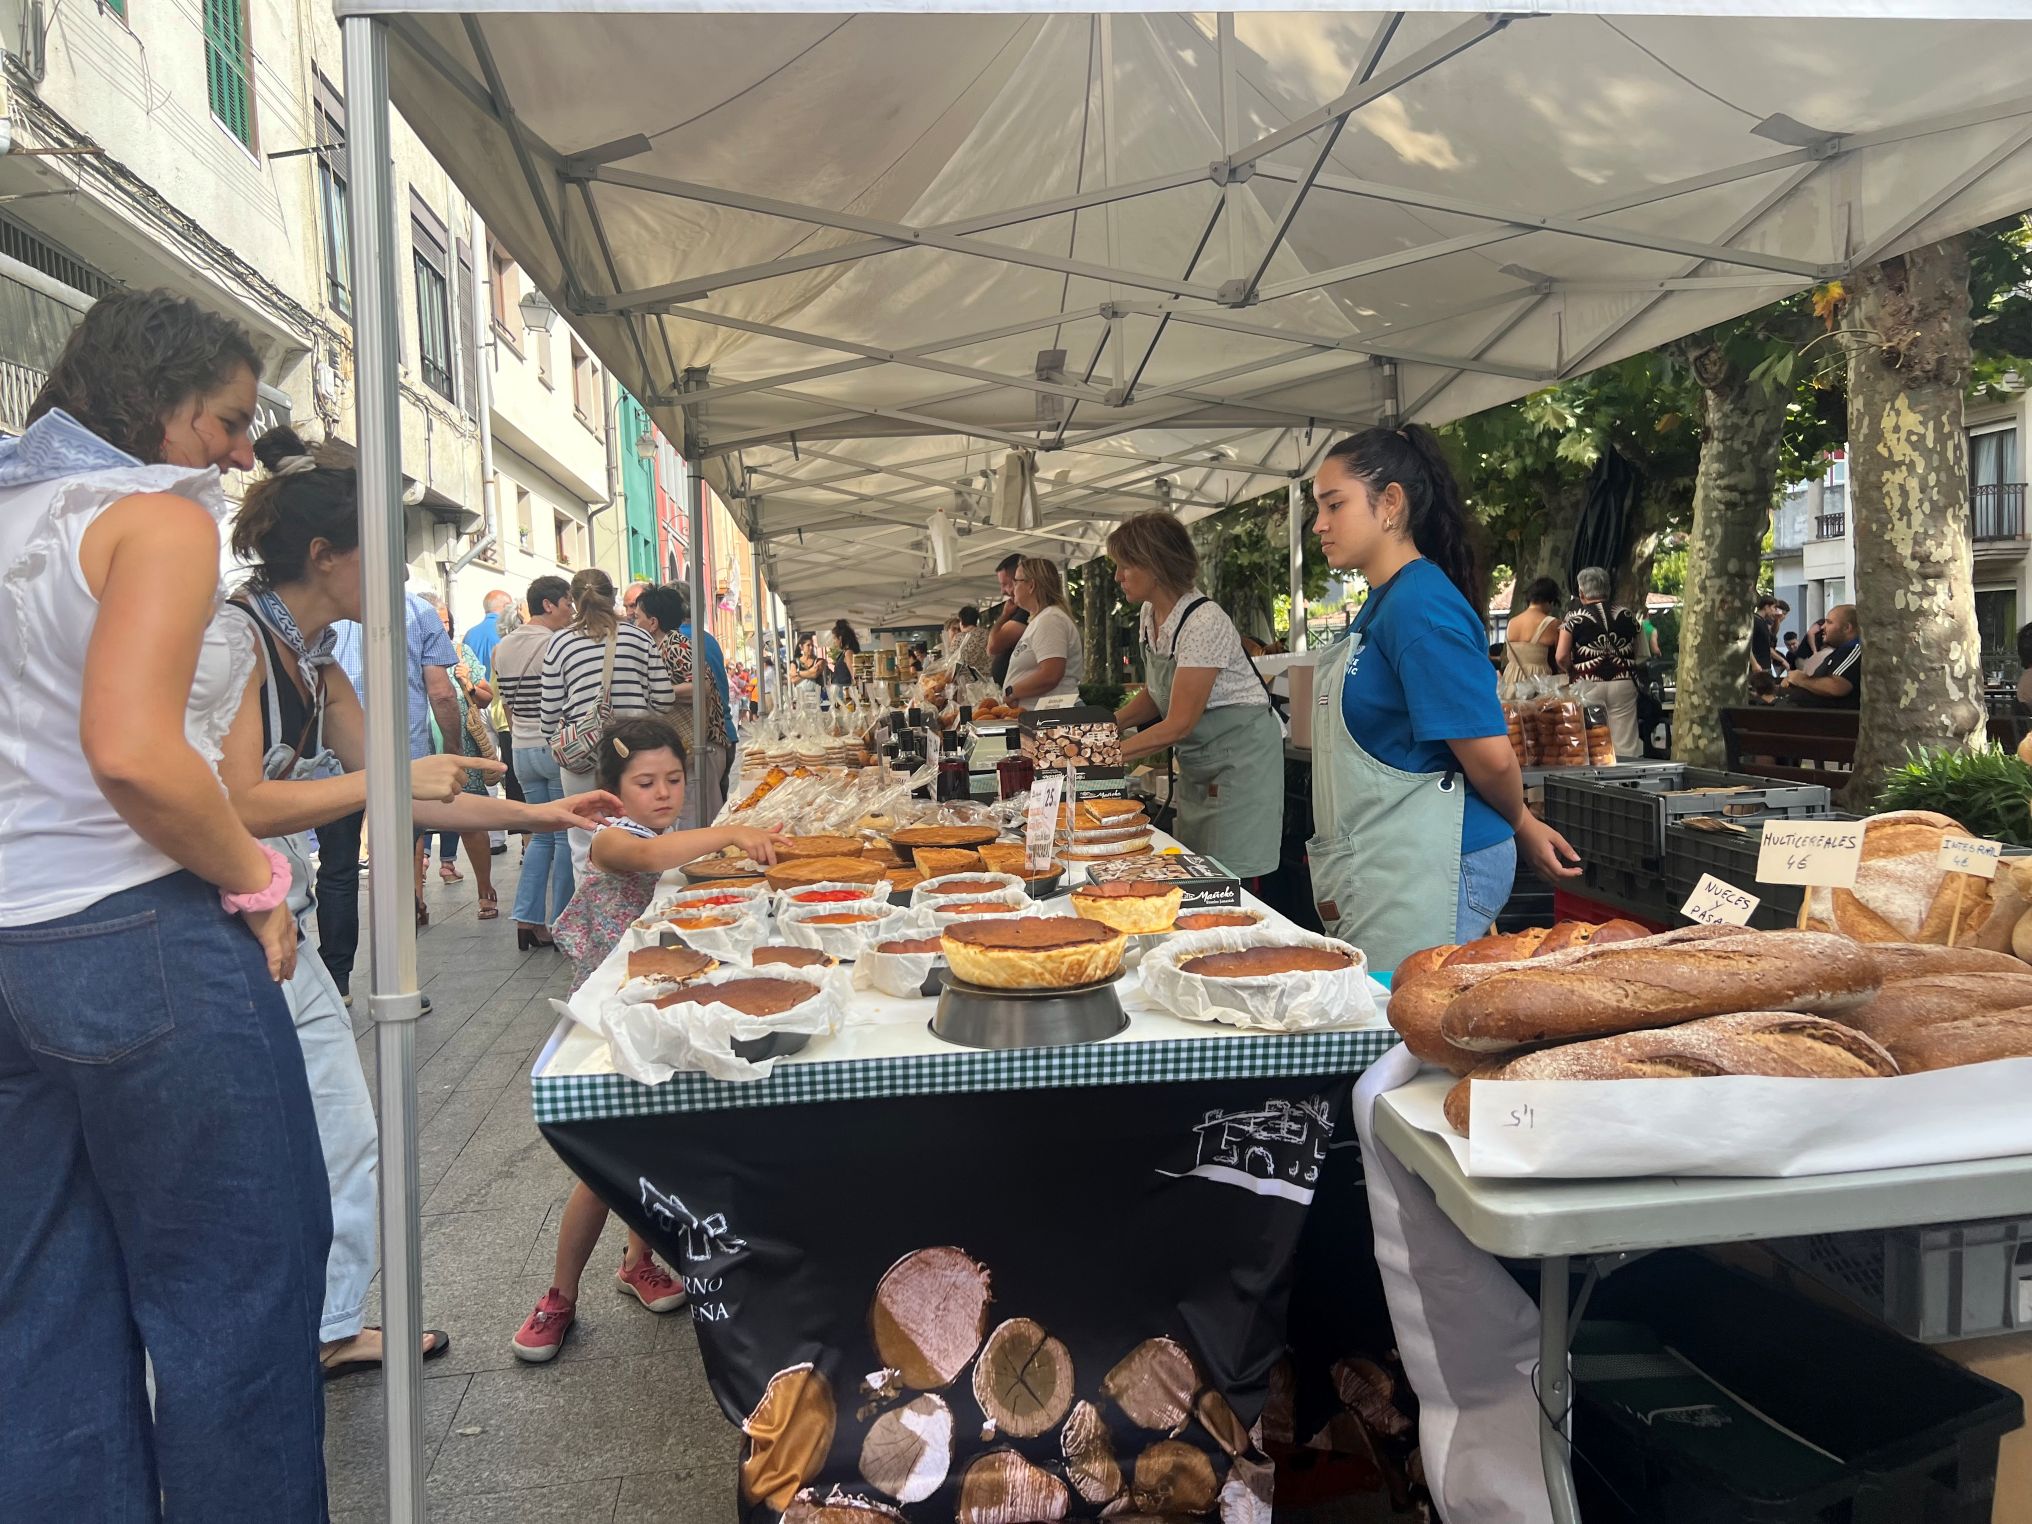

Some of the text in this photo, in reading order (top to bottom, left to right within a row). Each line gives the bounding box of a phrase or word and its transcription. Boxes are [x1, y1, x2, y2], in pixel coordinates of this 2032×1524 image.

[1763, 832, 1857, 850] MULTICEREALES
[1787, 854, 1811, 870] 4€
[1704, 881, 1751, 910] NUECES
[1690, 905, 1730, 925] PASA
